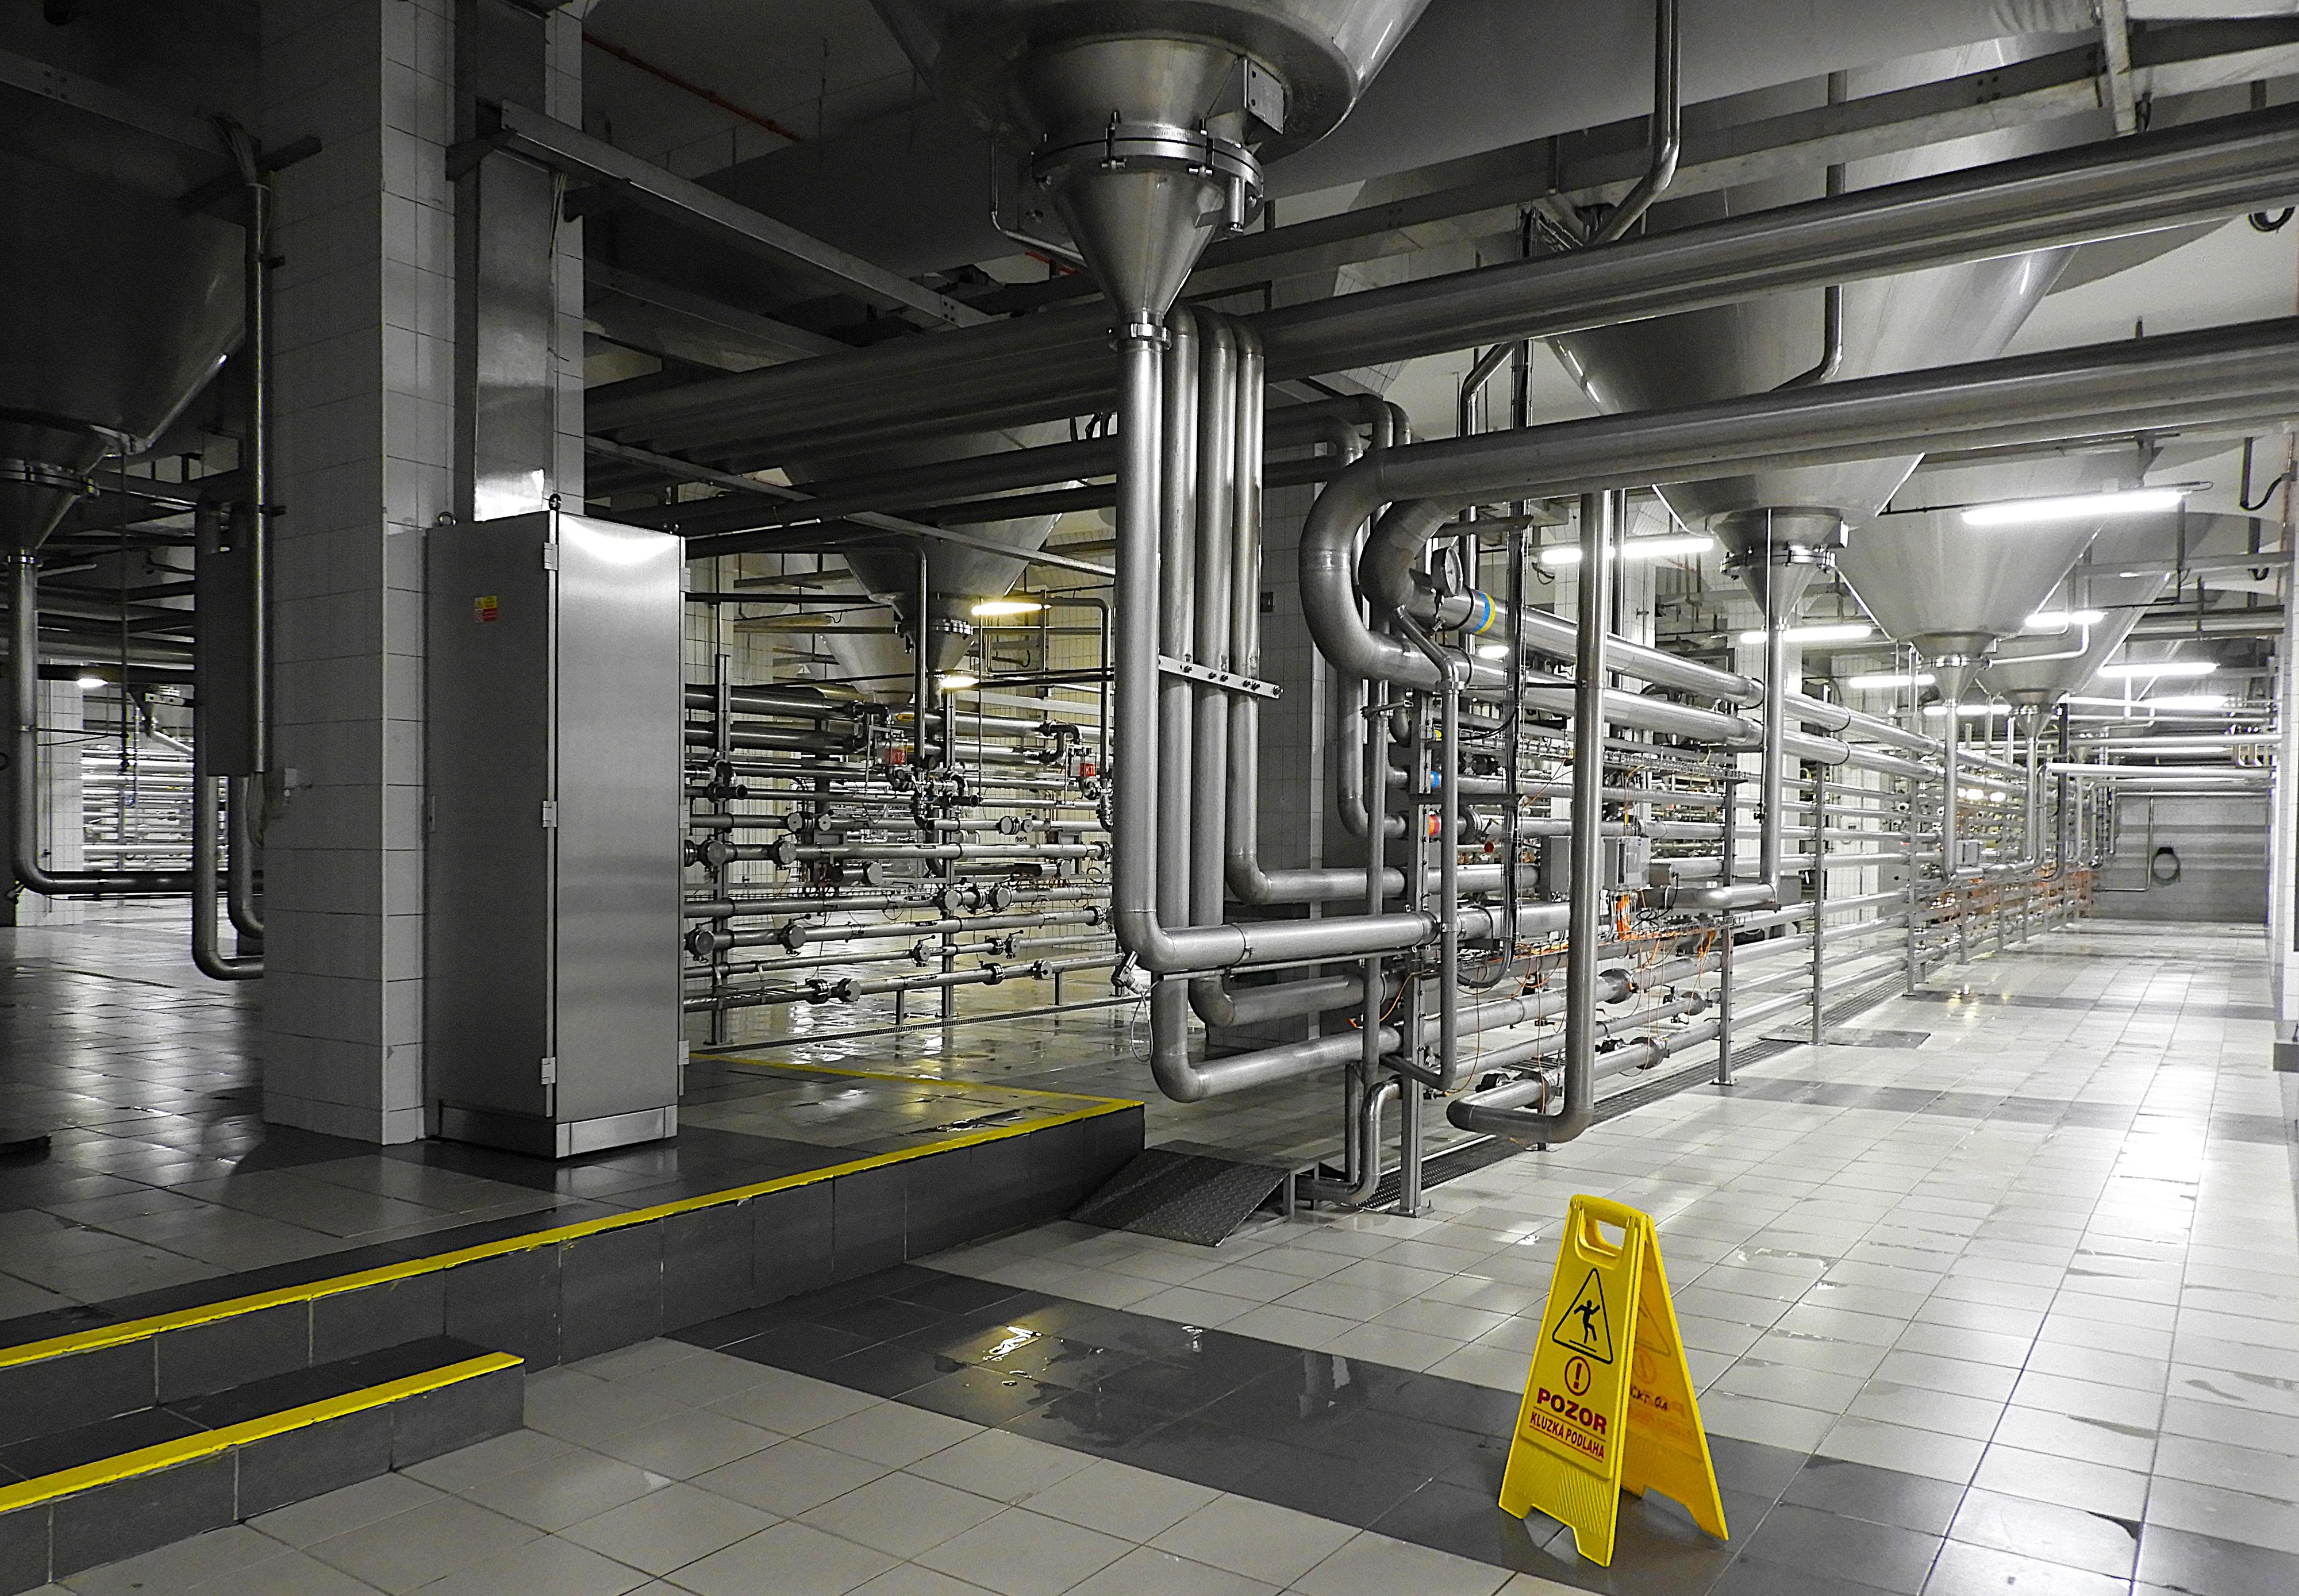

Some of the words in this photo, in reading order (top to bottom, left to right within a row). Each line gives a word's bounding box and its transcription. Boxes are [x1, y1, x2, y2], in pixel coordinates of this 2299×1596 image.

[1537, 1387, 1607, 1435] POZOR
[1530, 1412, 1564, 1438] KLUZKA
[1565, 1428, 1604, 1459] PODLAHA
